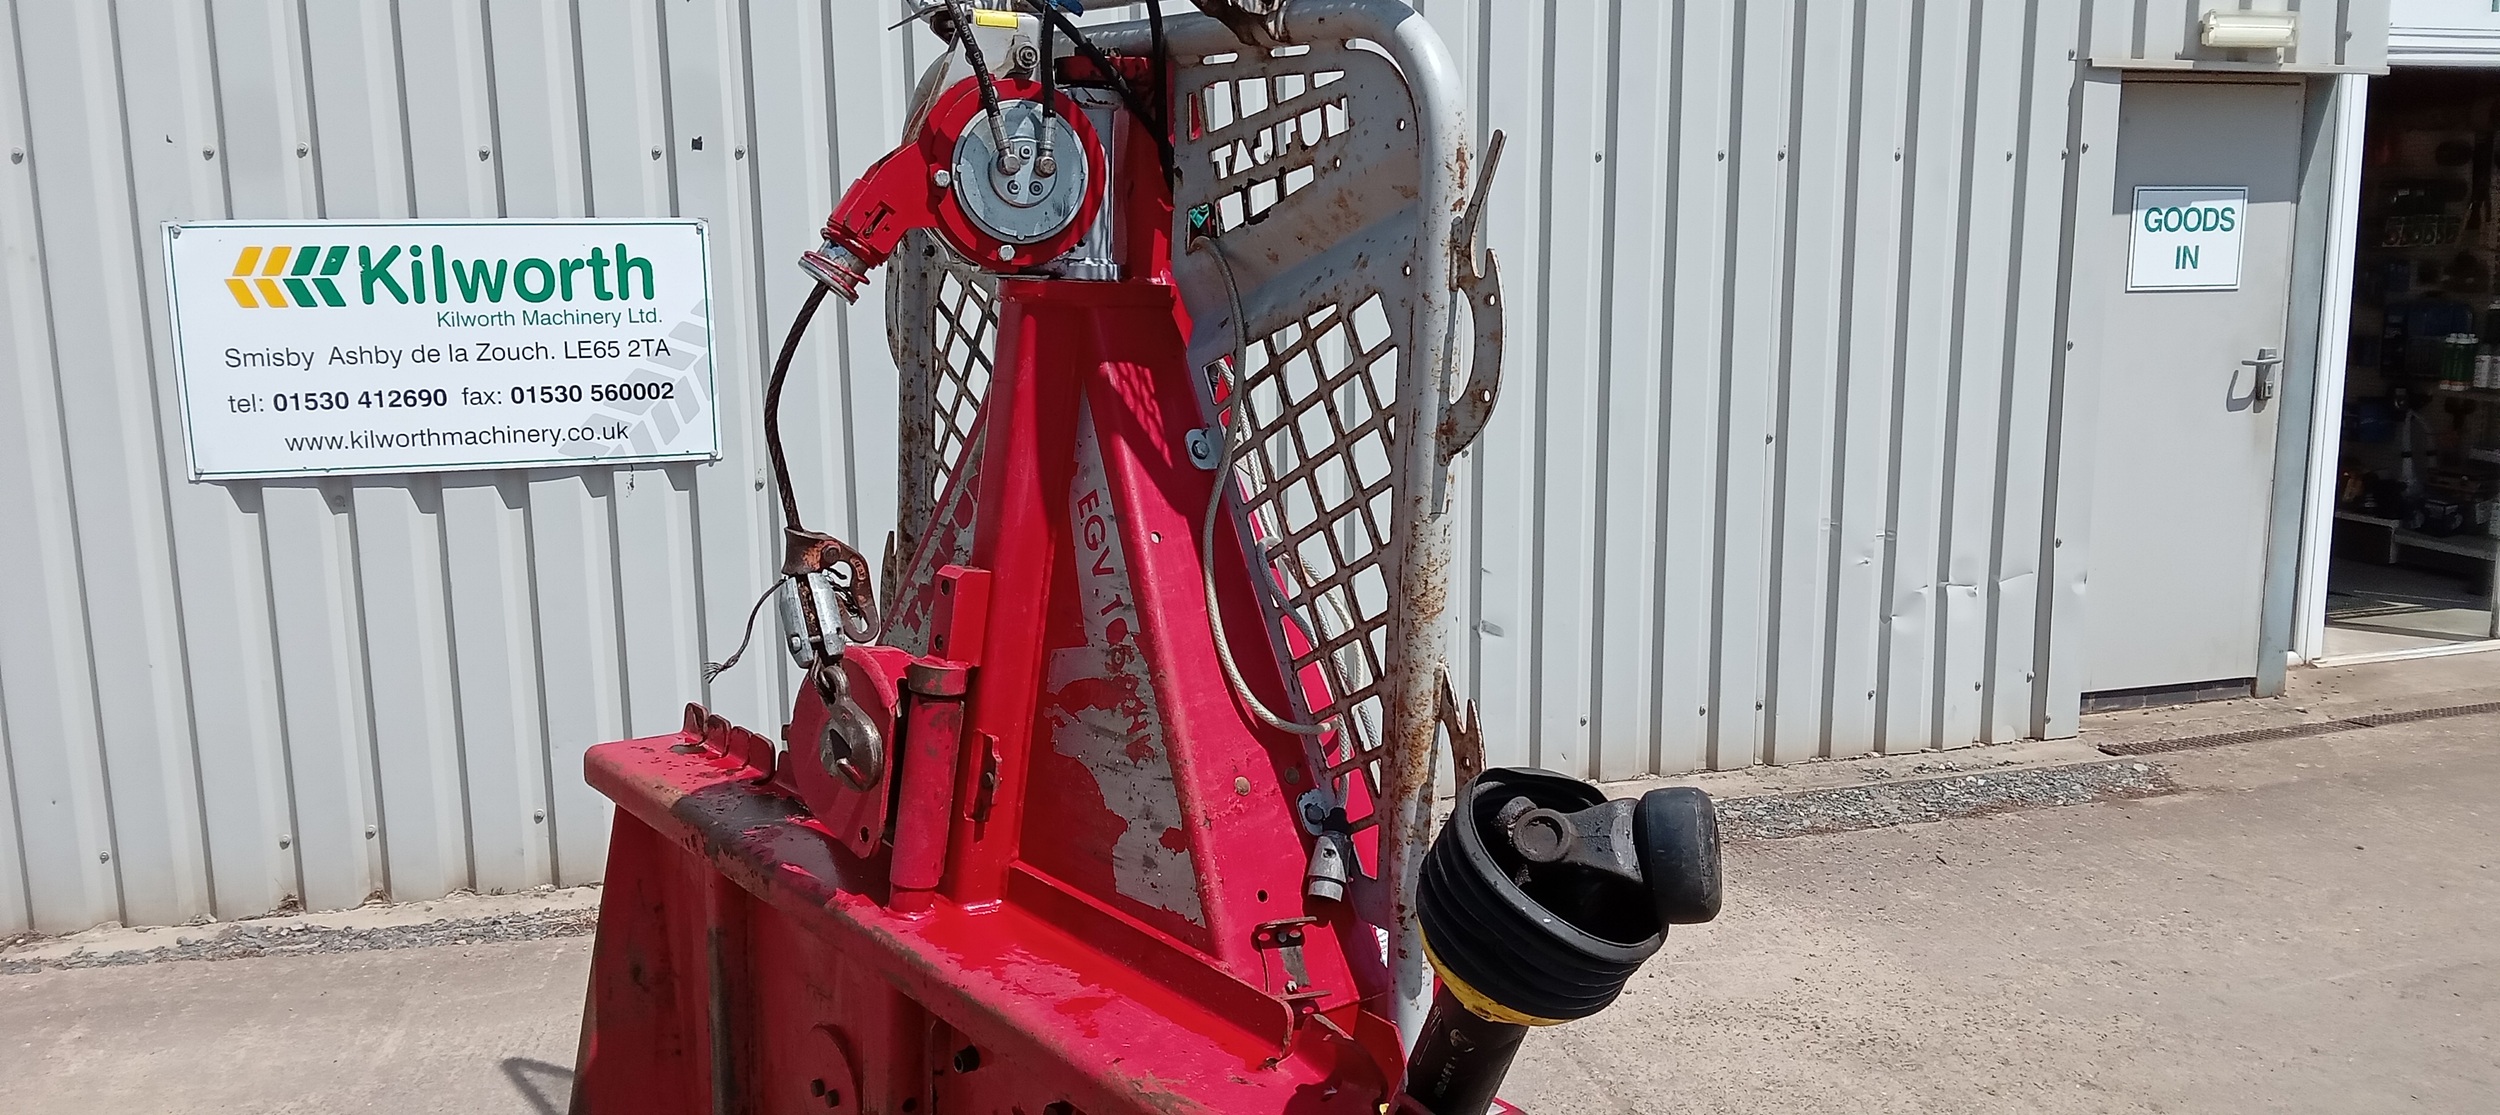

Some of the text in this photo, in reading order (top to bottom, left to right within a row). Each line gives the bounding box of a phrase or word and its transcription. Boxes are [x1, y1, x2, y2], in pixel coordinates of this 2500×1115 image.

[1210, 97, 1350, 180] TAJFUN
[2144, 206, 2236, 233] GOODS
[357, 242, 656, 306] Kilworth
[2175, 244, 2200, 270] IN
[436, 306, 664, 329] Kilworth Machinery Ltd.
[224, 337, 672, 372] Smisby Ashby de la Zouch. LE65 2TA
[226, 380, 676, 414] tel: 01530 412690 fax: 01530 560002
[283, 420, 630, 453] www.kilworthmachinery.co.uk
[1076, 488, 1115, 578] EGV
